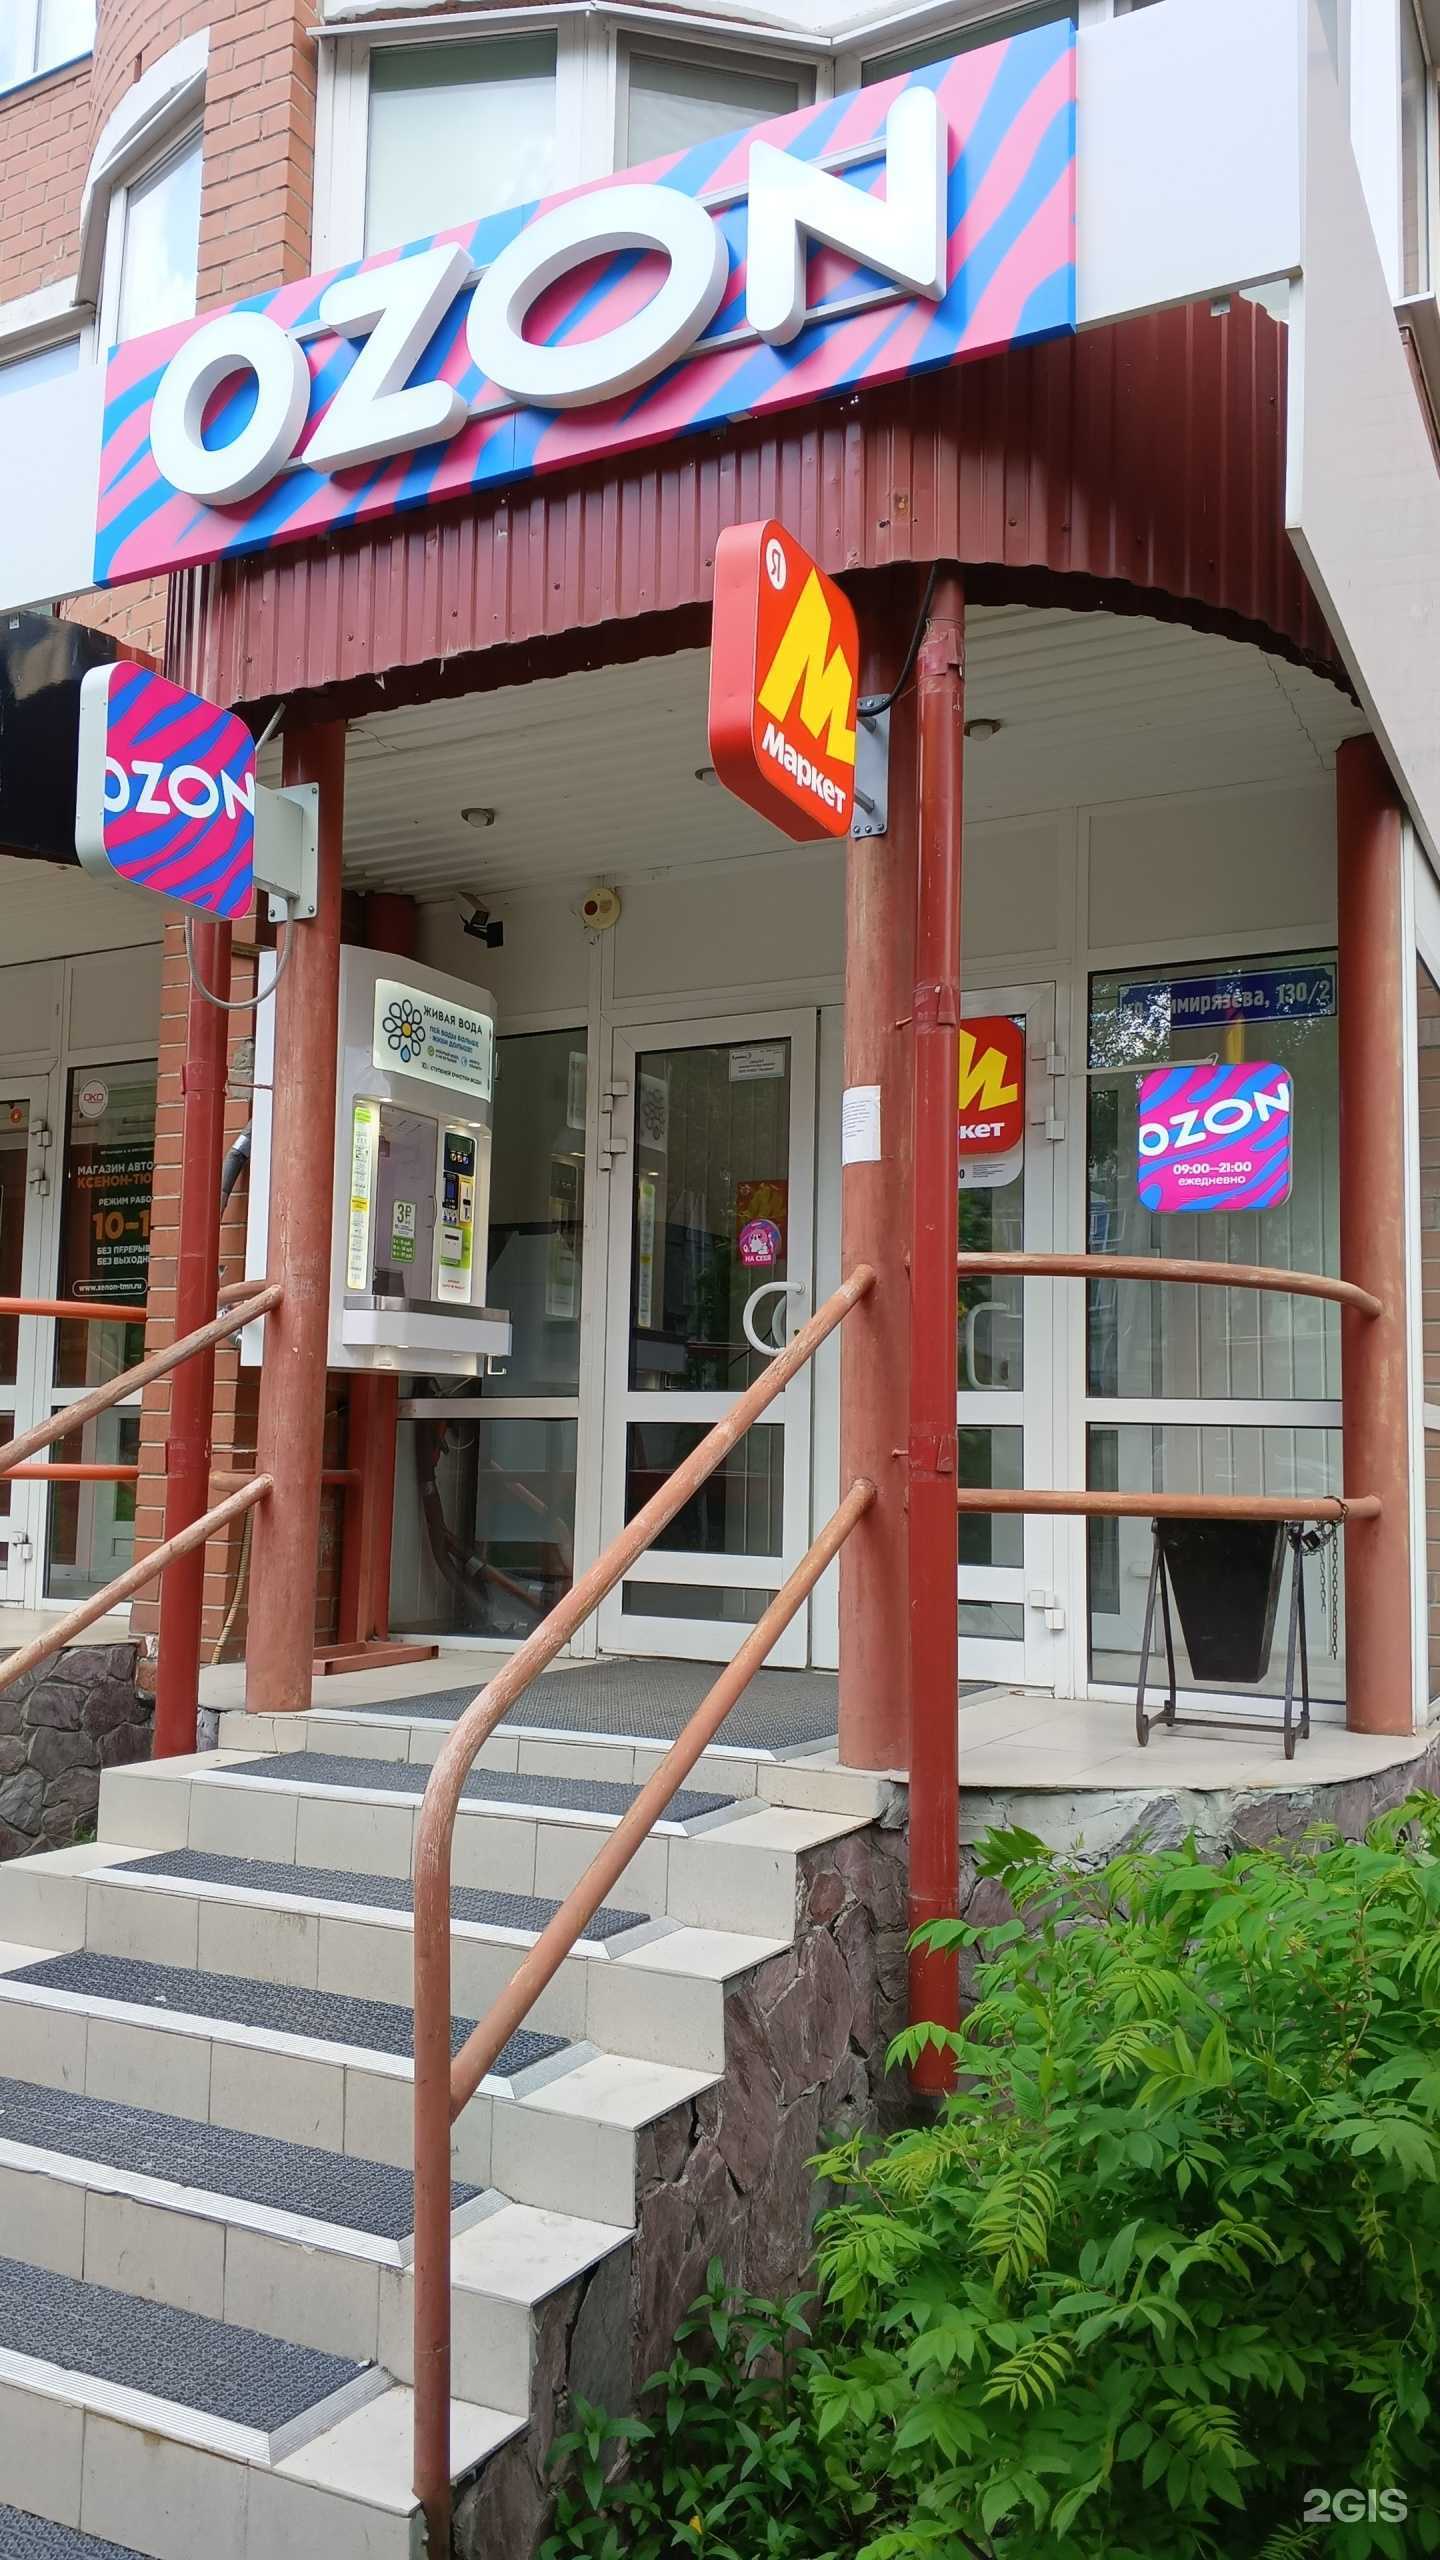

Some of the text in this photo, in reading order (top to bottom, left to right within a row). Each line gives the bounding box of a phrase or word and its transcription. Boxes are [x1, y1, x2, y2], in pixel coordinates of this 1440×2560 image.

[149, 86, 948, 505] OZON
[762, 722, 847, 813] Маркет
[104, 755, 255, 820] OZON
[1152, 989, 1269, 1016] имирязева,
[1276, 980, 1331, 1008] 130/2
[423, 1005, 483, 1035] ЖИВАЯ ВОДА
[960, 1122, 1005, 1139] кет
[1139, 1083, 1290, 1157] OZON
[78, 1164, 126, 1176] МАГАЗИН
[1178, 1176, 1246, 1187] ежедневно
[98, 1195, 152, 1207] РЕЖИМ РАБО
[96, 1246, 112, 1255] БЕЗ
[96, 1257, 112, 1266] БЕЗ
